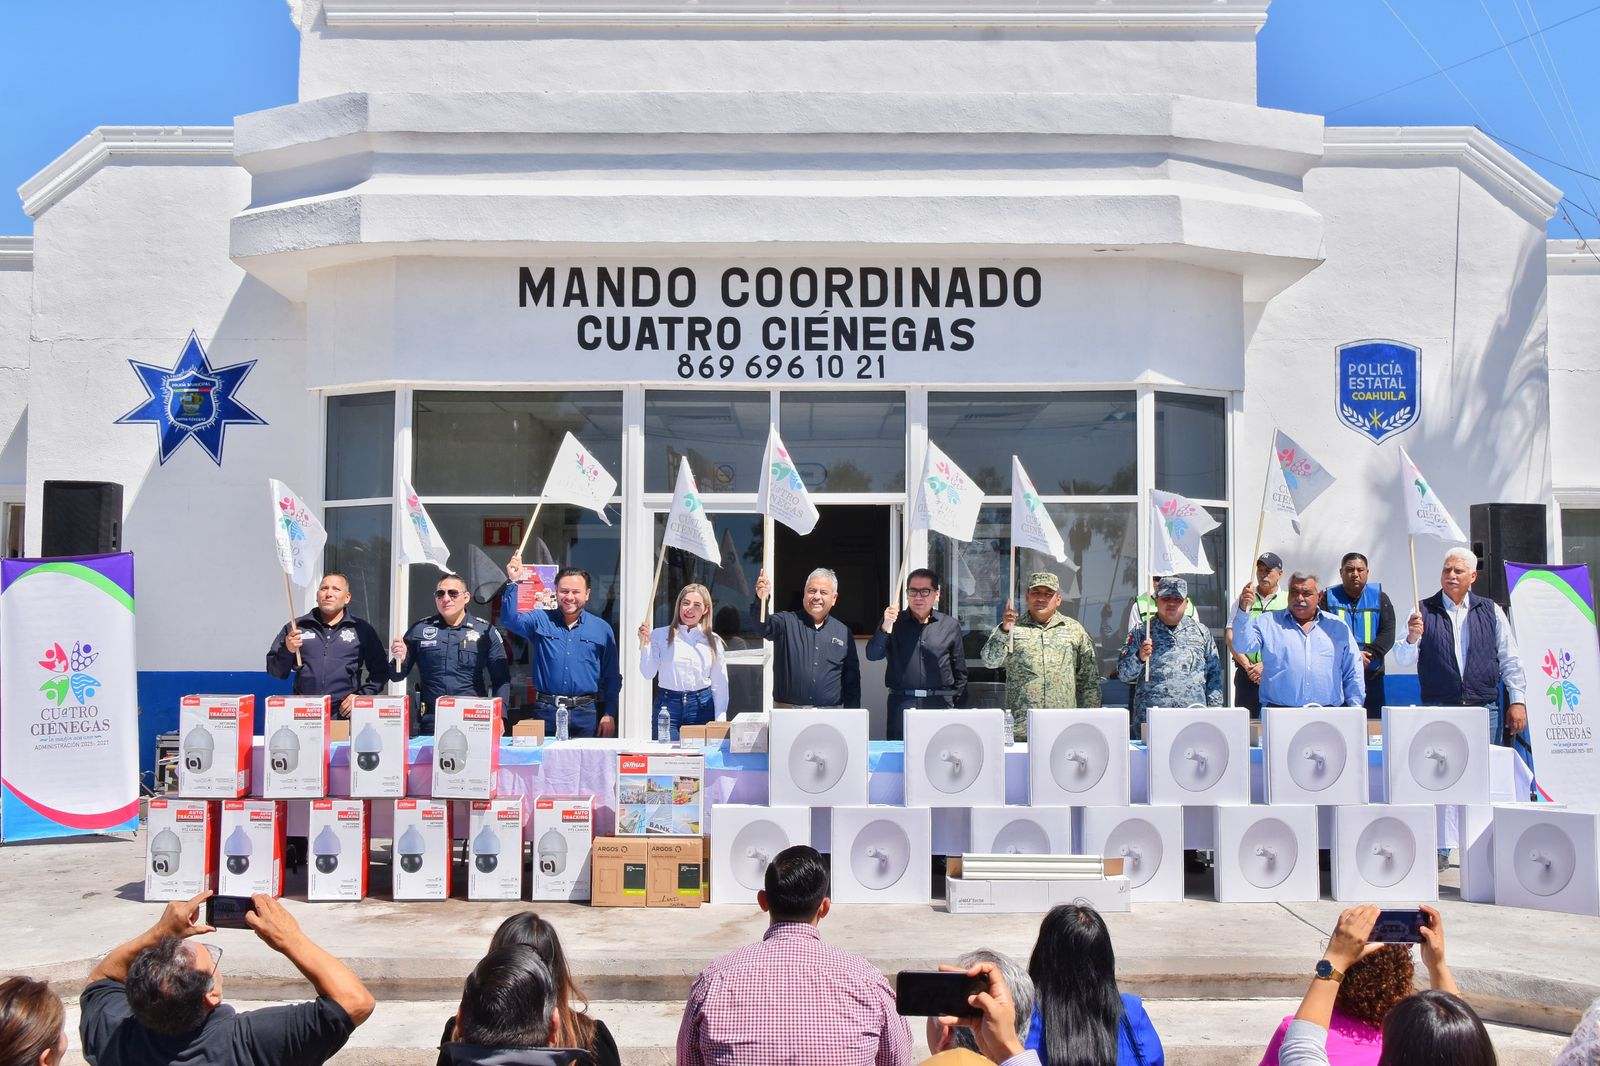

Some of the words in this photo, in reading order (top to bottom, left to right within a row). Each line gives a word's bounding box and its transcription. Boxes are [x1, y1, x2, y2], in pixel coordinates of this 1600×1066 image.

[519, 266, 697, 308] MANDO
[720, 266, 1042, 308] COORDINADO
[577, 315, 741, 351] CUATRO
[761, 309, 976, 352] CIÉNEGAS
[677, 354, 735, 379] 869
[745, 354, 805, 379] 696
[816, 354, 844, 379] 10
[856, 354, 885, 379] 21
[1348, 360, 1403, 375] POLICÍA
[1349, 377, 1406, 389] ESTATAL
[1352, 391, 1406, 400] COAHUILA
[30, 719, 110, 736] CIÉNEGAS
[648, 821, 671, 833] BANK
